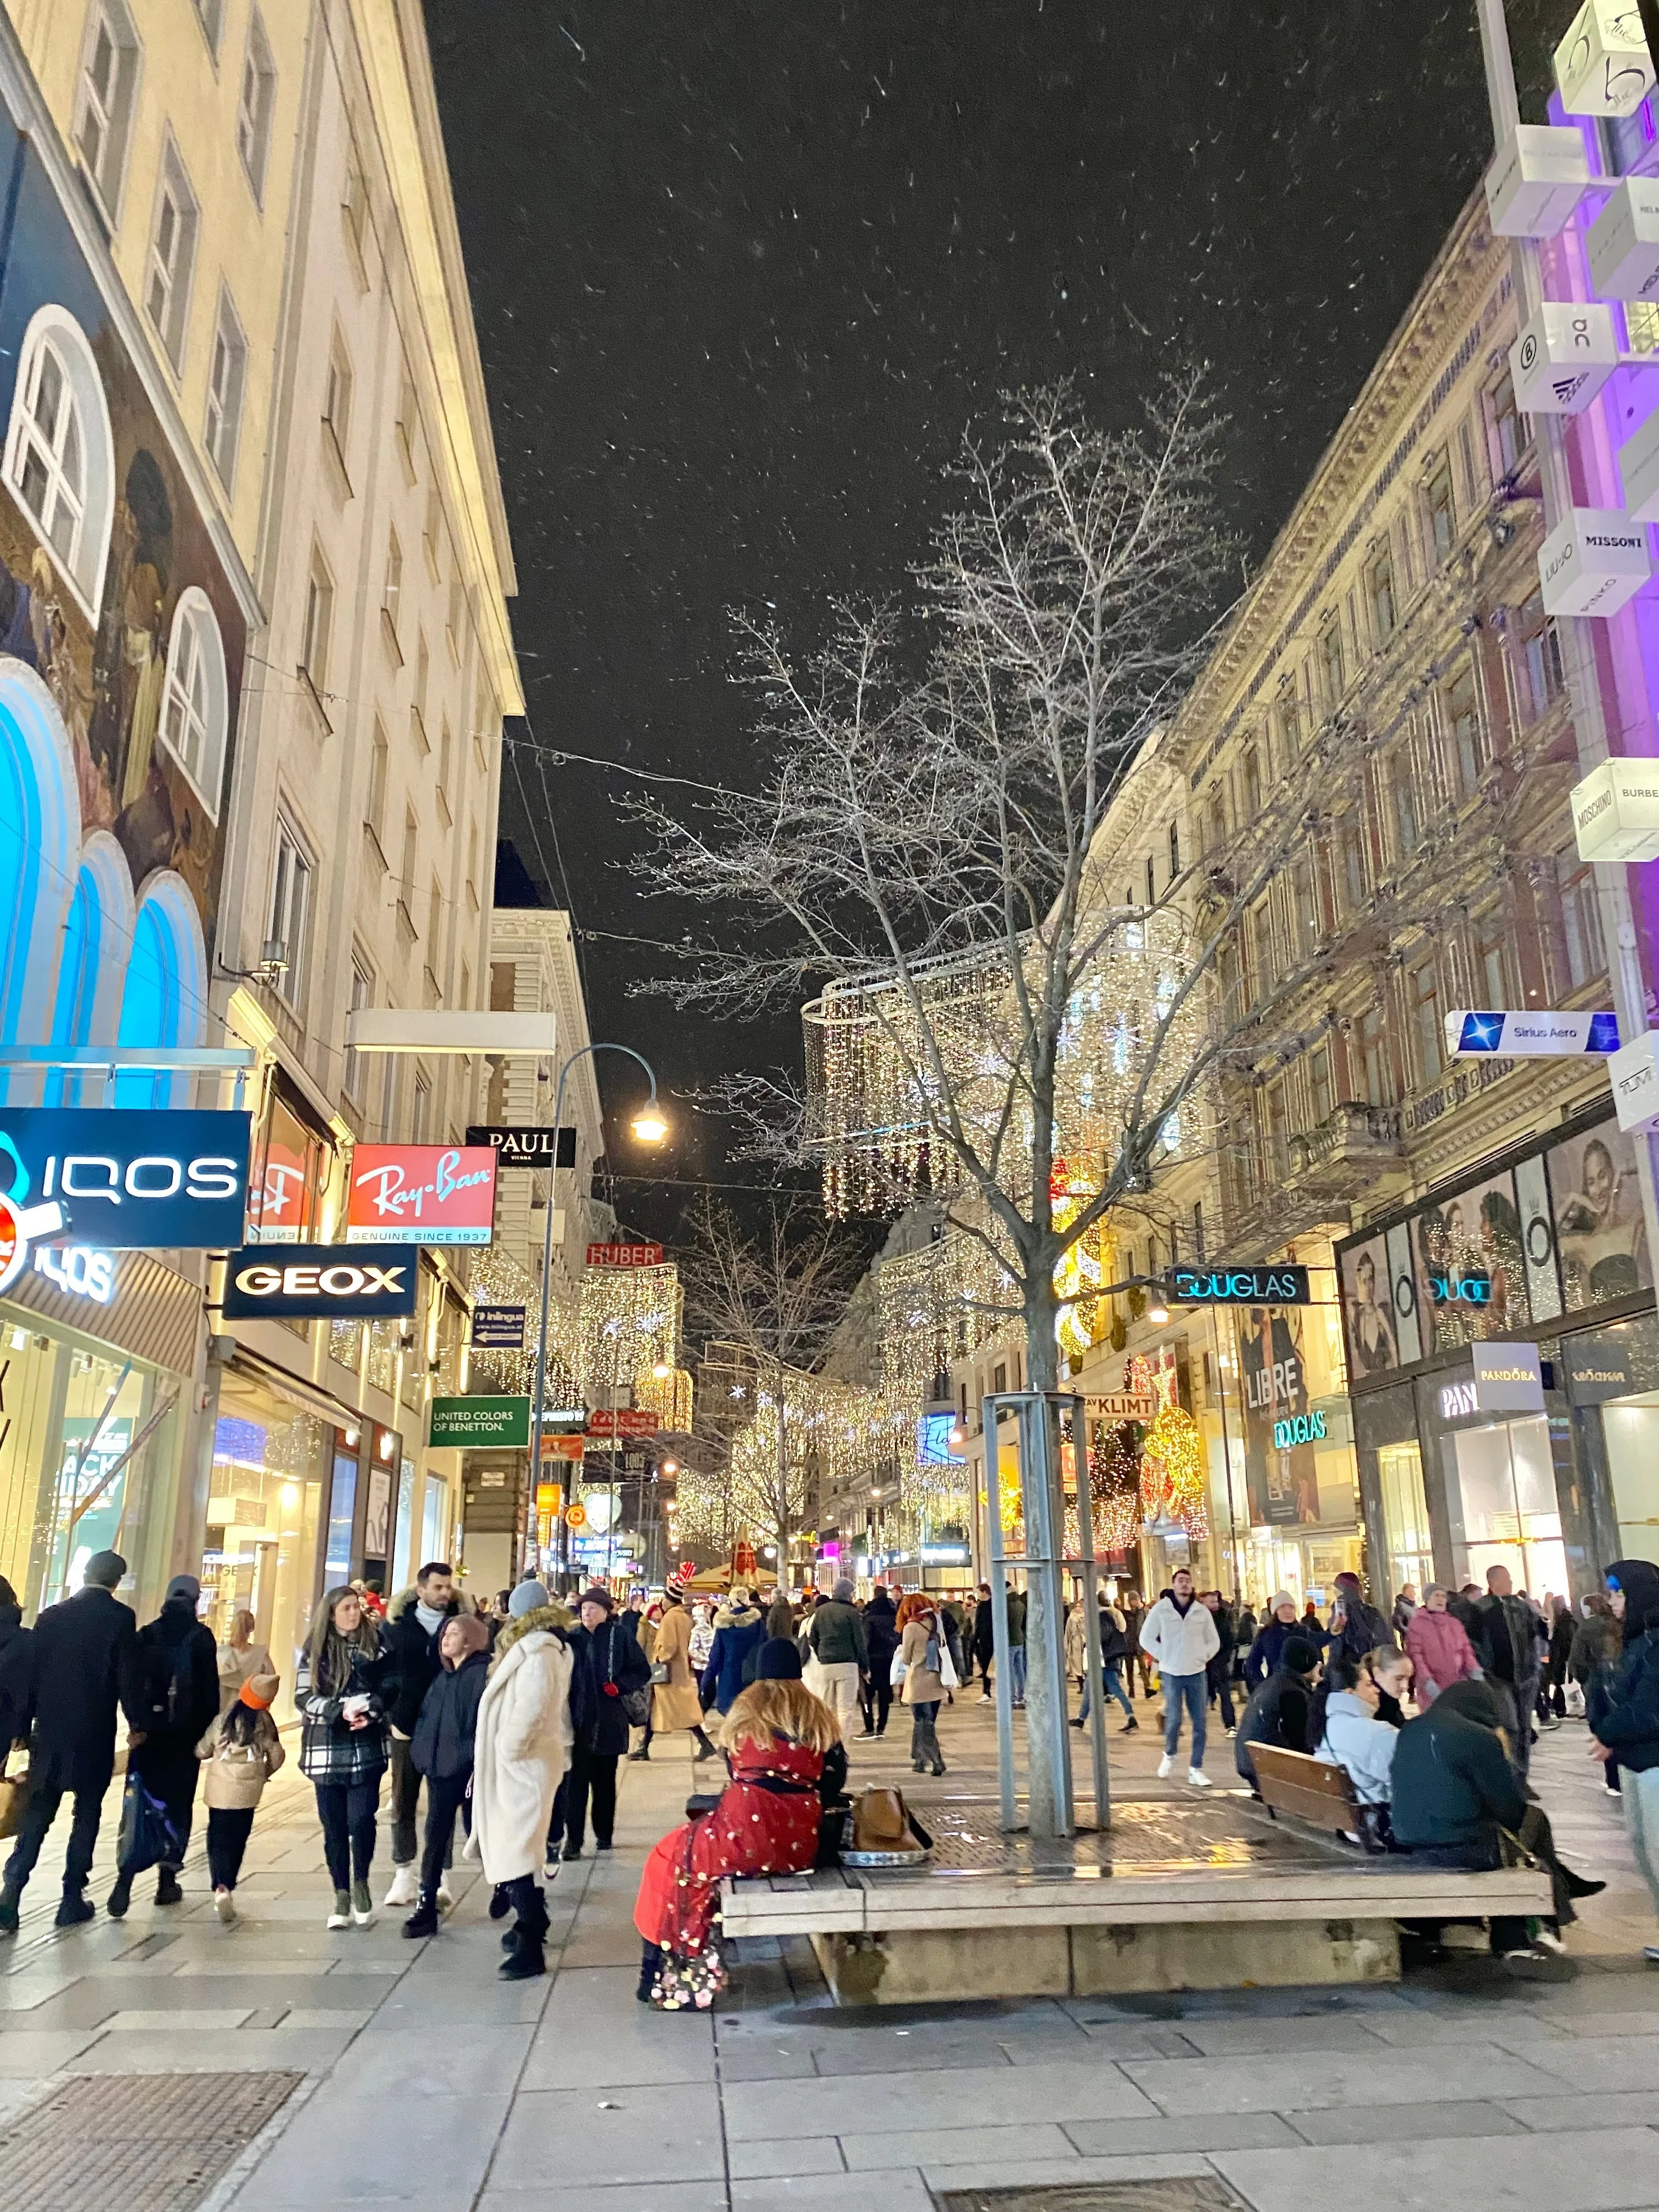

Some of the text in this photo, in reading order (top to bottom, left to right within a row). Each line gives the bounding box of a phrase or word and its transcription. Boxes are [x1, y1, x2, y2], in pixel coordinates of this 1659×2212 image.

[1585, 536, 1641, 548] MISSONI
[1622, 789, 1659, 797] BURBE
[1578, 789, 1612, 831] MOSCHINO
[1514, 1028, 1577, 1037] Sirius Aero
[489, 1133, 554, 1153] PAUL
[42, 1156, 238, 1204] IQOS
[591, 1246, 656, 1265] HUBER
[235, 1266, 407, 1296] GEOX
[1177, 1274, 1296, 1297] DOUGLAS
[1246, 1357, 1299, 1409] LIBRE
[1099, 1398, 1151, 1414] KLIMT
[434, 1412, 514, 1421] UNITED COLORS
[433, 1423, 448, 1432] OF
[1274, 1410, 1325, 1449] DOUGLAS
[61, 1455, 119, 1476] ACK
